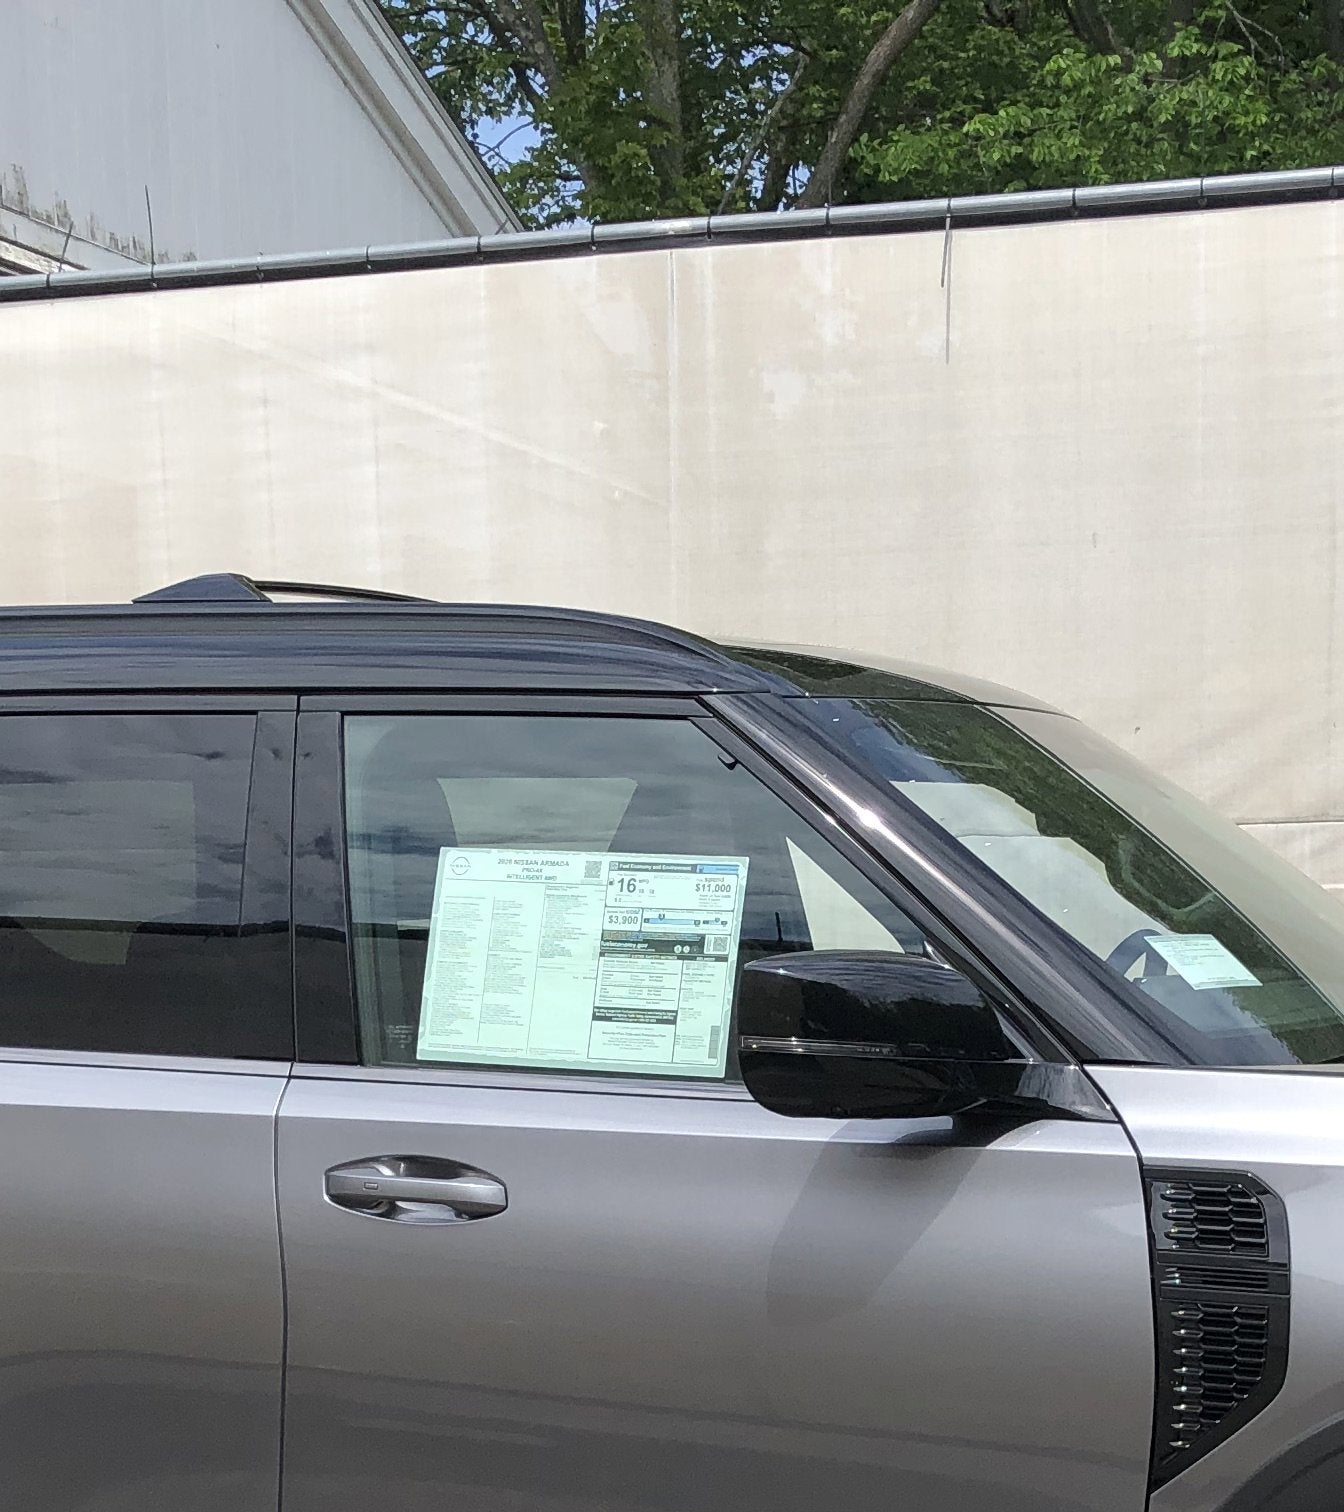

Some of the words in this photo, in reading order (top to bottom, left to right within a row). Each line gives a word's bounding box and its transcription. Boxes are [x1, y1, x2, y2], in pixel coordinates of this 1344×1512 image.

[617, 877, 637, 893] 16
[695, 883, 732, 893] $11,000
[608, 915, 639, 925] $3,900
